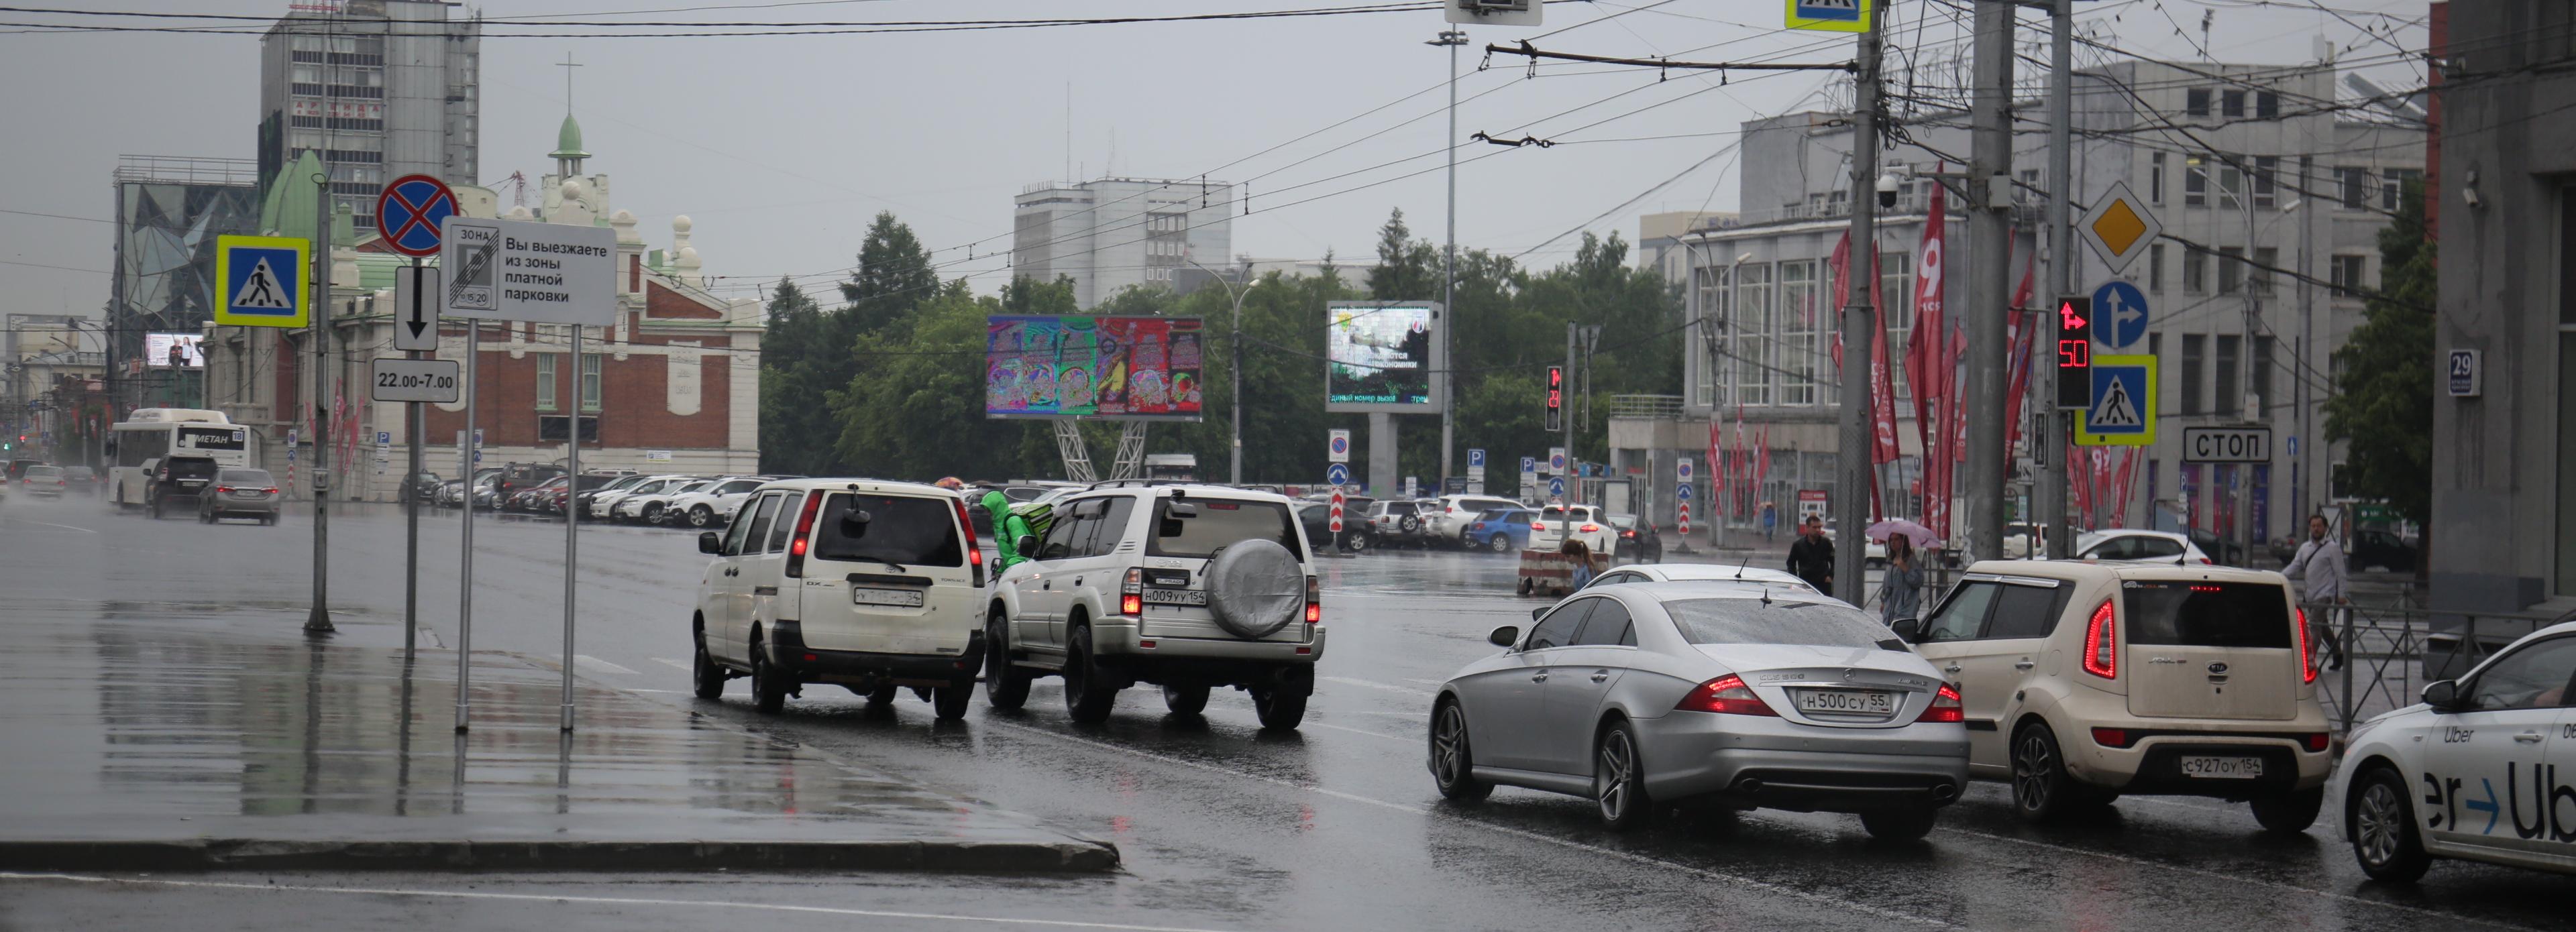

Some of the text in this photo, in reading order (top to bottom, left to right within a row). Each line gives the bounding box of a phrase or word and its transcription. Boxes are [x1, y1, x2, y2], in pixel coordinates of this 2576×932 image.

[461, 229, 489, 241] ЗОНА
[506, 237, 607, 257] Вы выезжаете
[506, 257, 561, 270] из зоны
[505, 273, 563, 286] платной
[477, 294, 487, 302] 20
[504, 289, 570, 303] парковки
[2059, 339, 2087, 367] 50
[2453, 355, 2471, 375] 29
[378, 372, 453, 388] 22.00-7.00
[1354, 395, 1375, 403] номер
[196, 434, 228, 444] МЕТАН
[233, 432, 242, 441] 18
[2196, 434, 2259, 457] СТОП
[1189, 592, 1203, 601] 154
[1870, 695, 1885, 706] 55
[2445, 725, 2474, 743] Uber
[2241, 758, 2260, 770] 154
